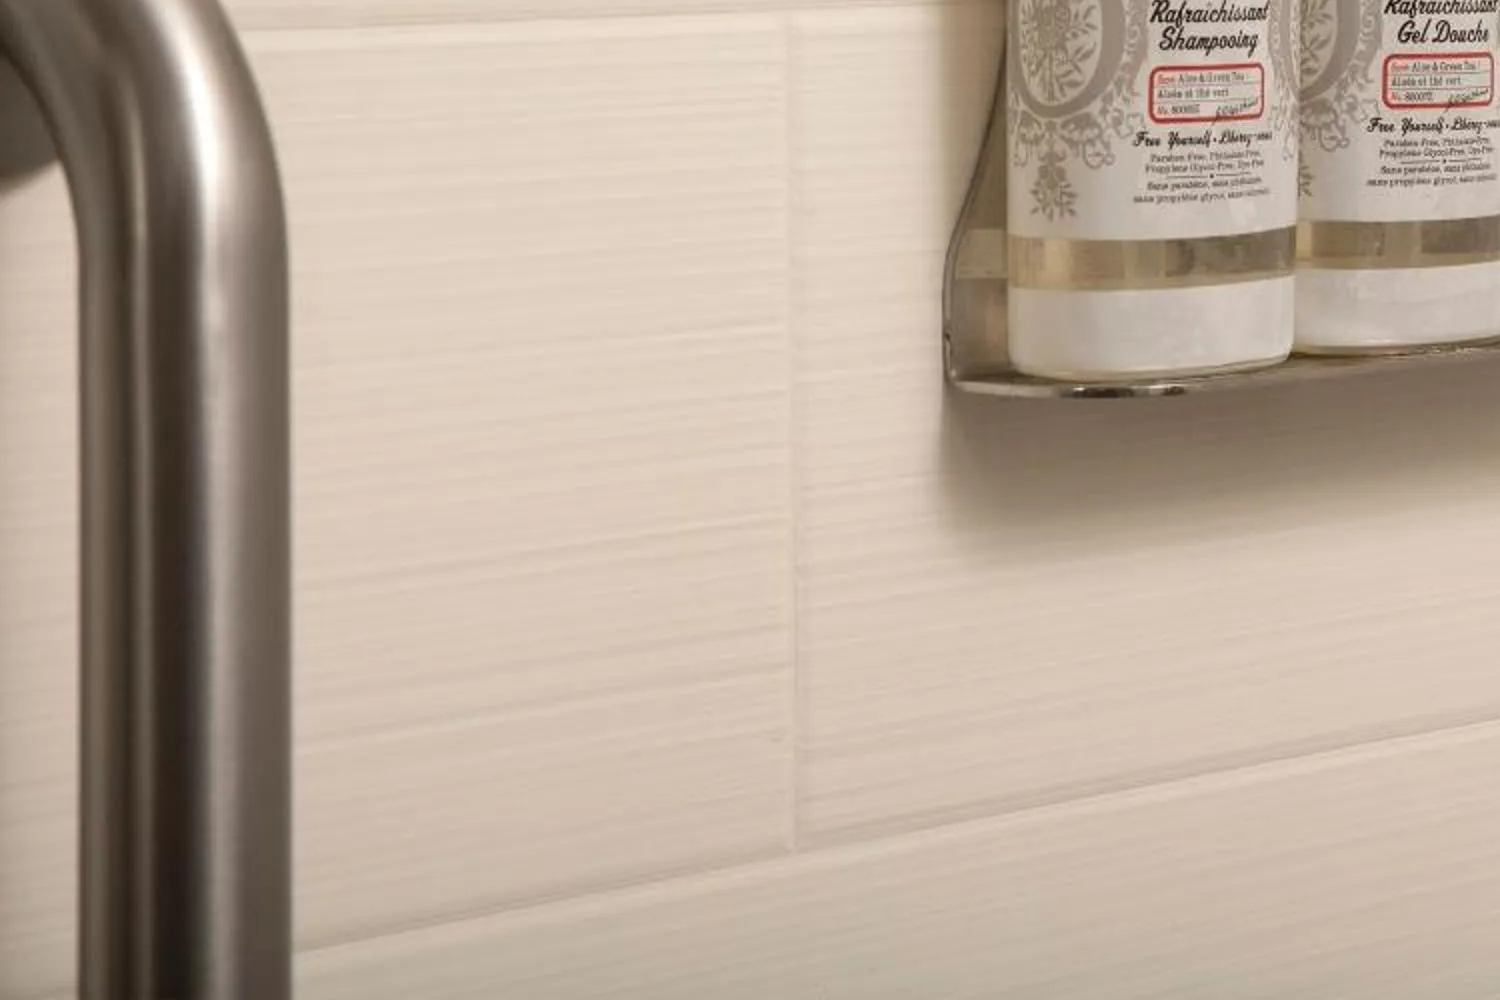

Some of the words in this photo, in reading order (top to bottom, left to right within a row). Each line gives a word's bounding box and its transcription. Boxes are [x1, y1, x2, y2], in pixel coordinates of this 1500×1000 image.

[1159, 26, 1259, 58] Shampooing
[1398, 19, 1432, 43] Gel
[1432, 19, 1489, 43] Douche
